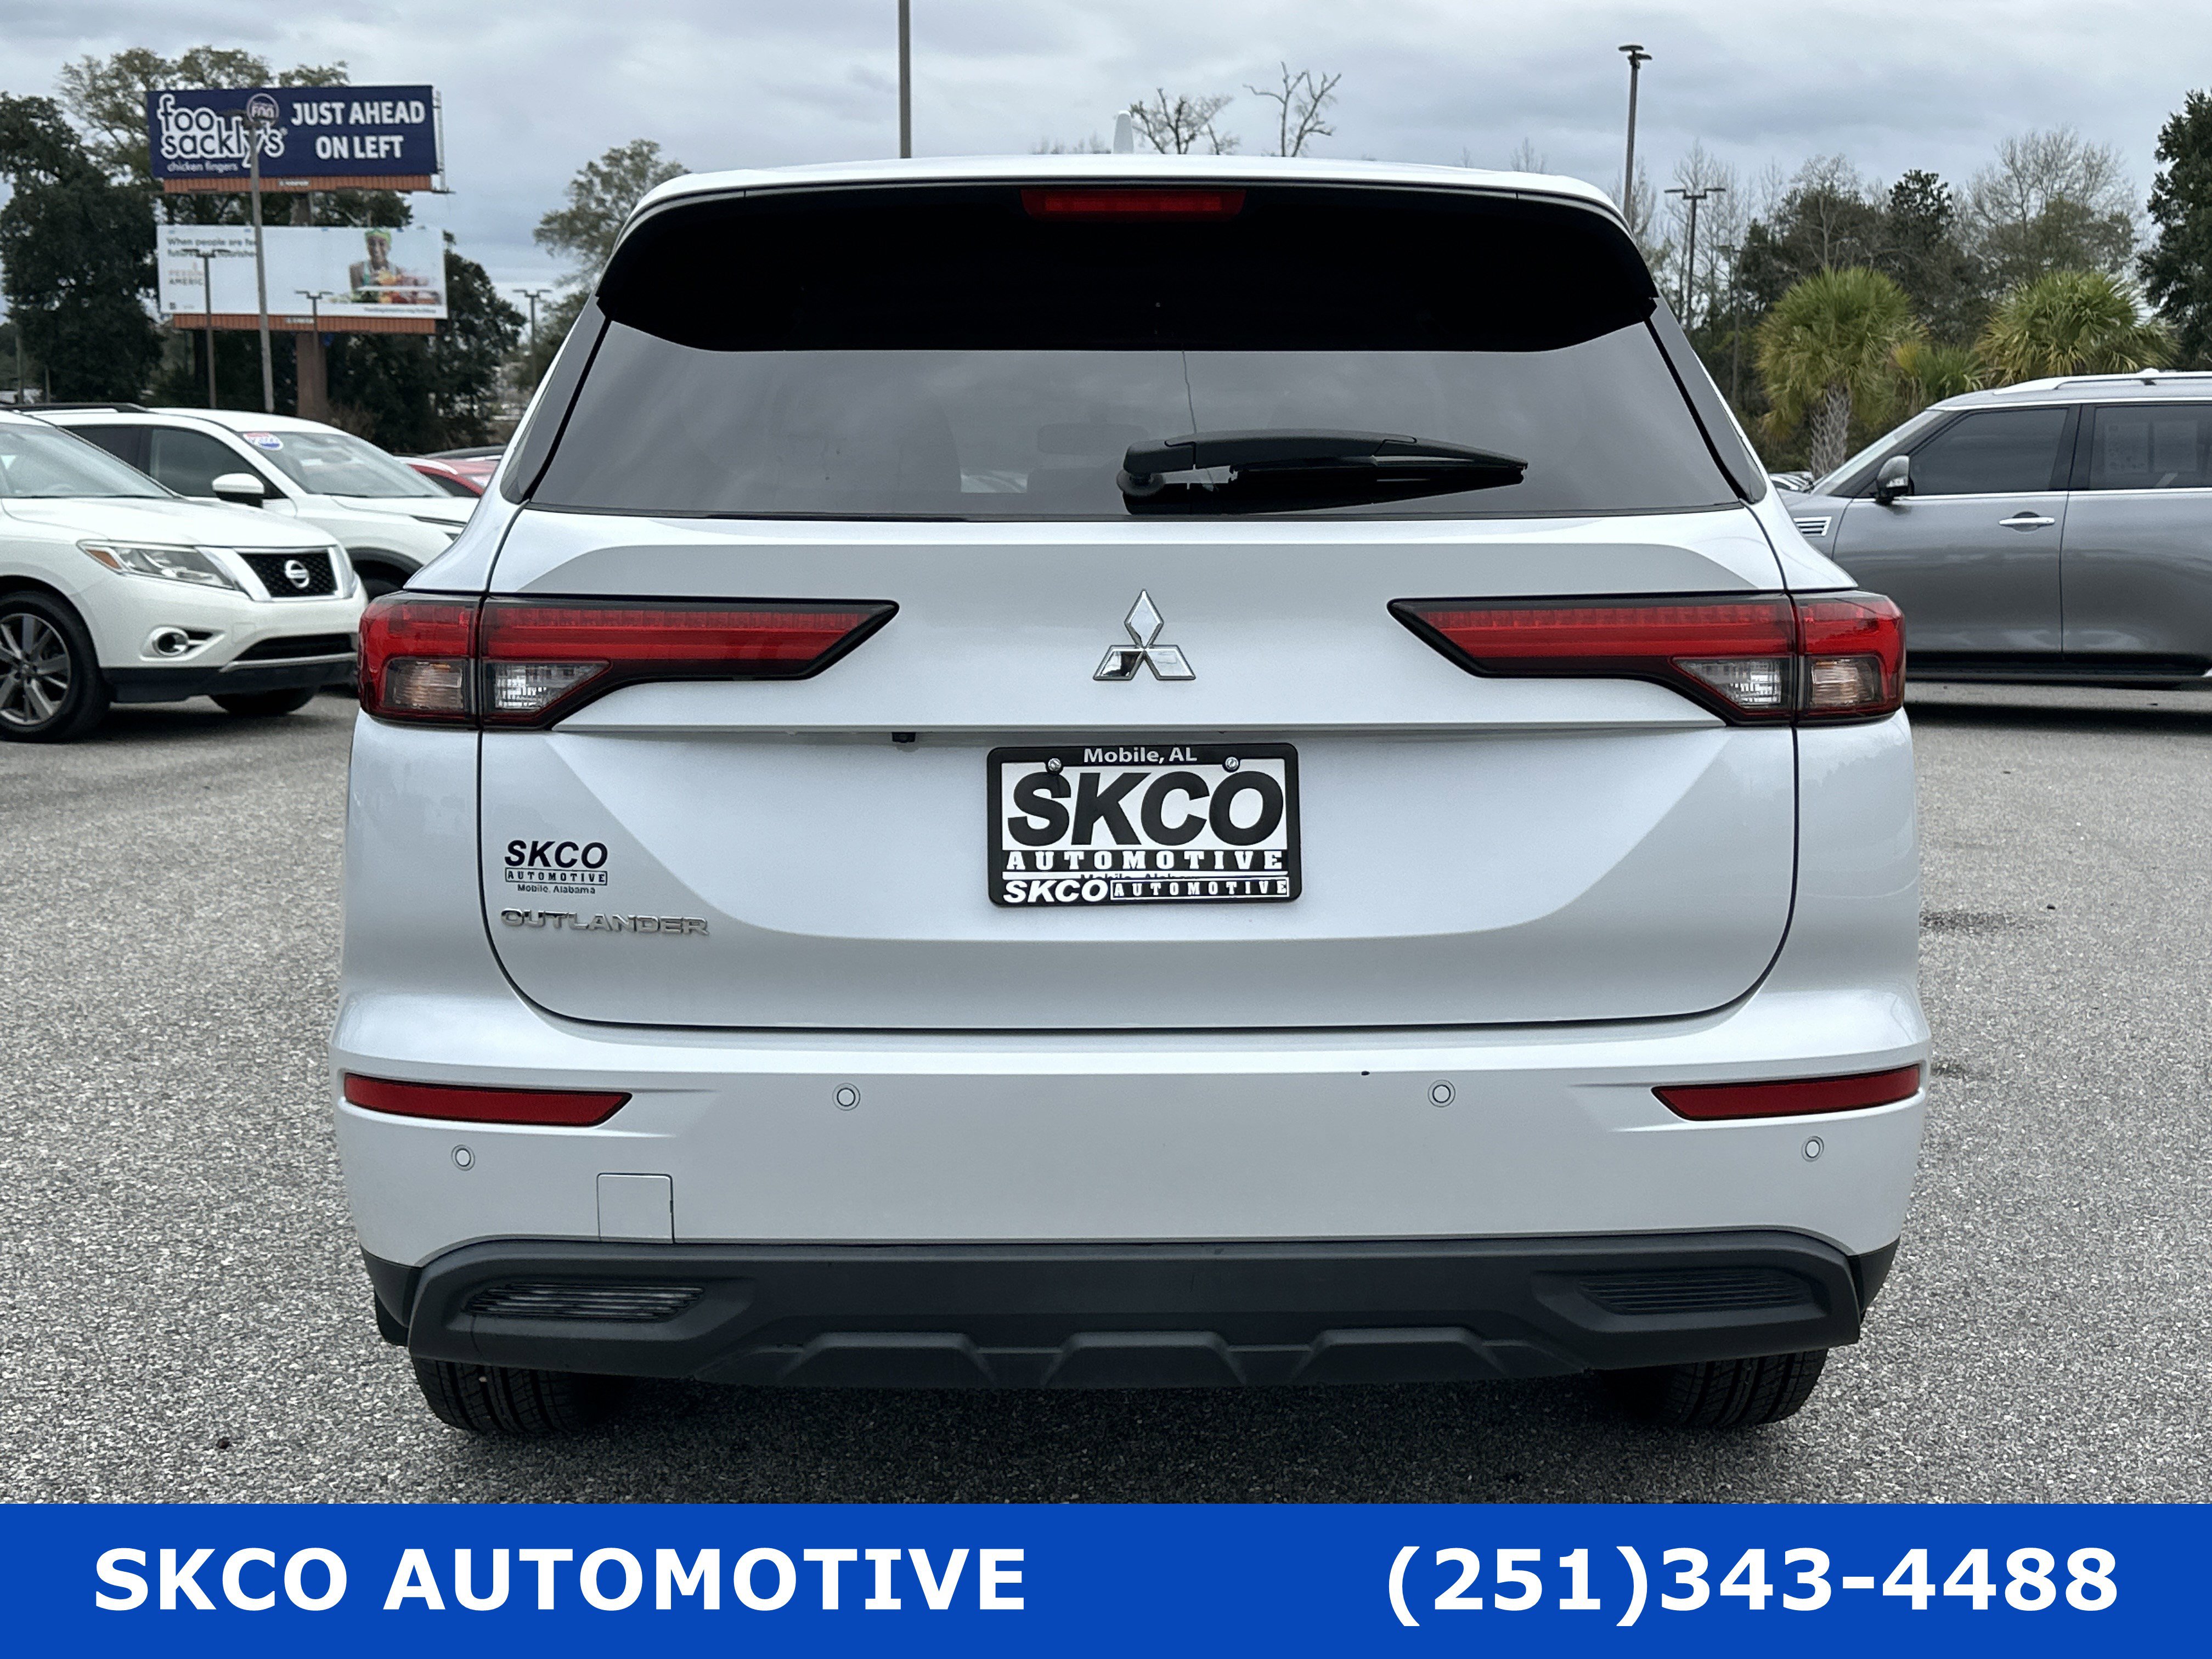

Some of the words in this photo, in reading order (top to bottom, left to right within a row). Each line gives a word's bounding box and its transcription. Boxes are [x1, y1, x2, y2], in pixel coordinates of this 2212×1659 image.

[157, 93, 217, 133] foo
[291, 101, 346, 126] JUST
[349, 100, 425, 125] AHEAD
[315, 136, 349, 159] ON
[353, 135, 404, 159] LEFT
[1084, 747, 1165, 764] Mobile,
[1169, 747, 1198, 762] AL
[1007, 771, 1284, 846] SKCO
[504, 840, 608, 869] SKCO
[1006, 850, 1283, 871] AUTOMOTIVE
[507, 871, 605, 883] AUTOMOTIVE
[553, 885, 595, 894] Alabama
[1003, 879, 1108, 903] SKCO
[1113, 881, 1287, 897] AUTOMOTIVE
[501, 907, 710, 935] OUTLANDER
